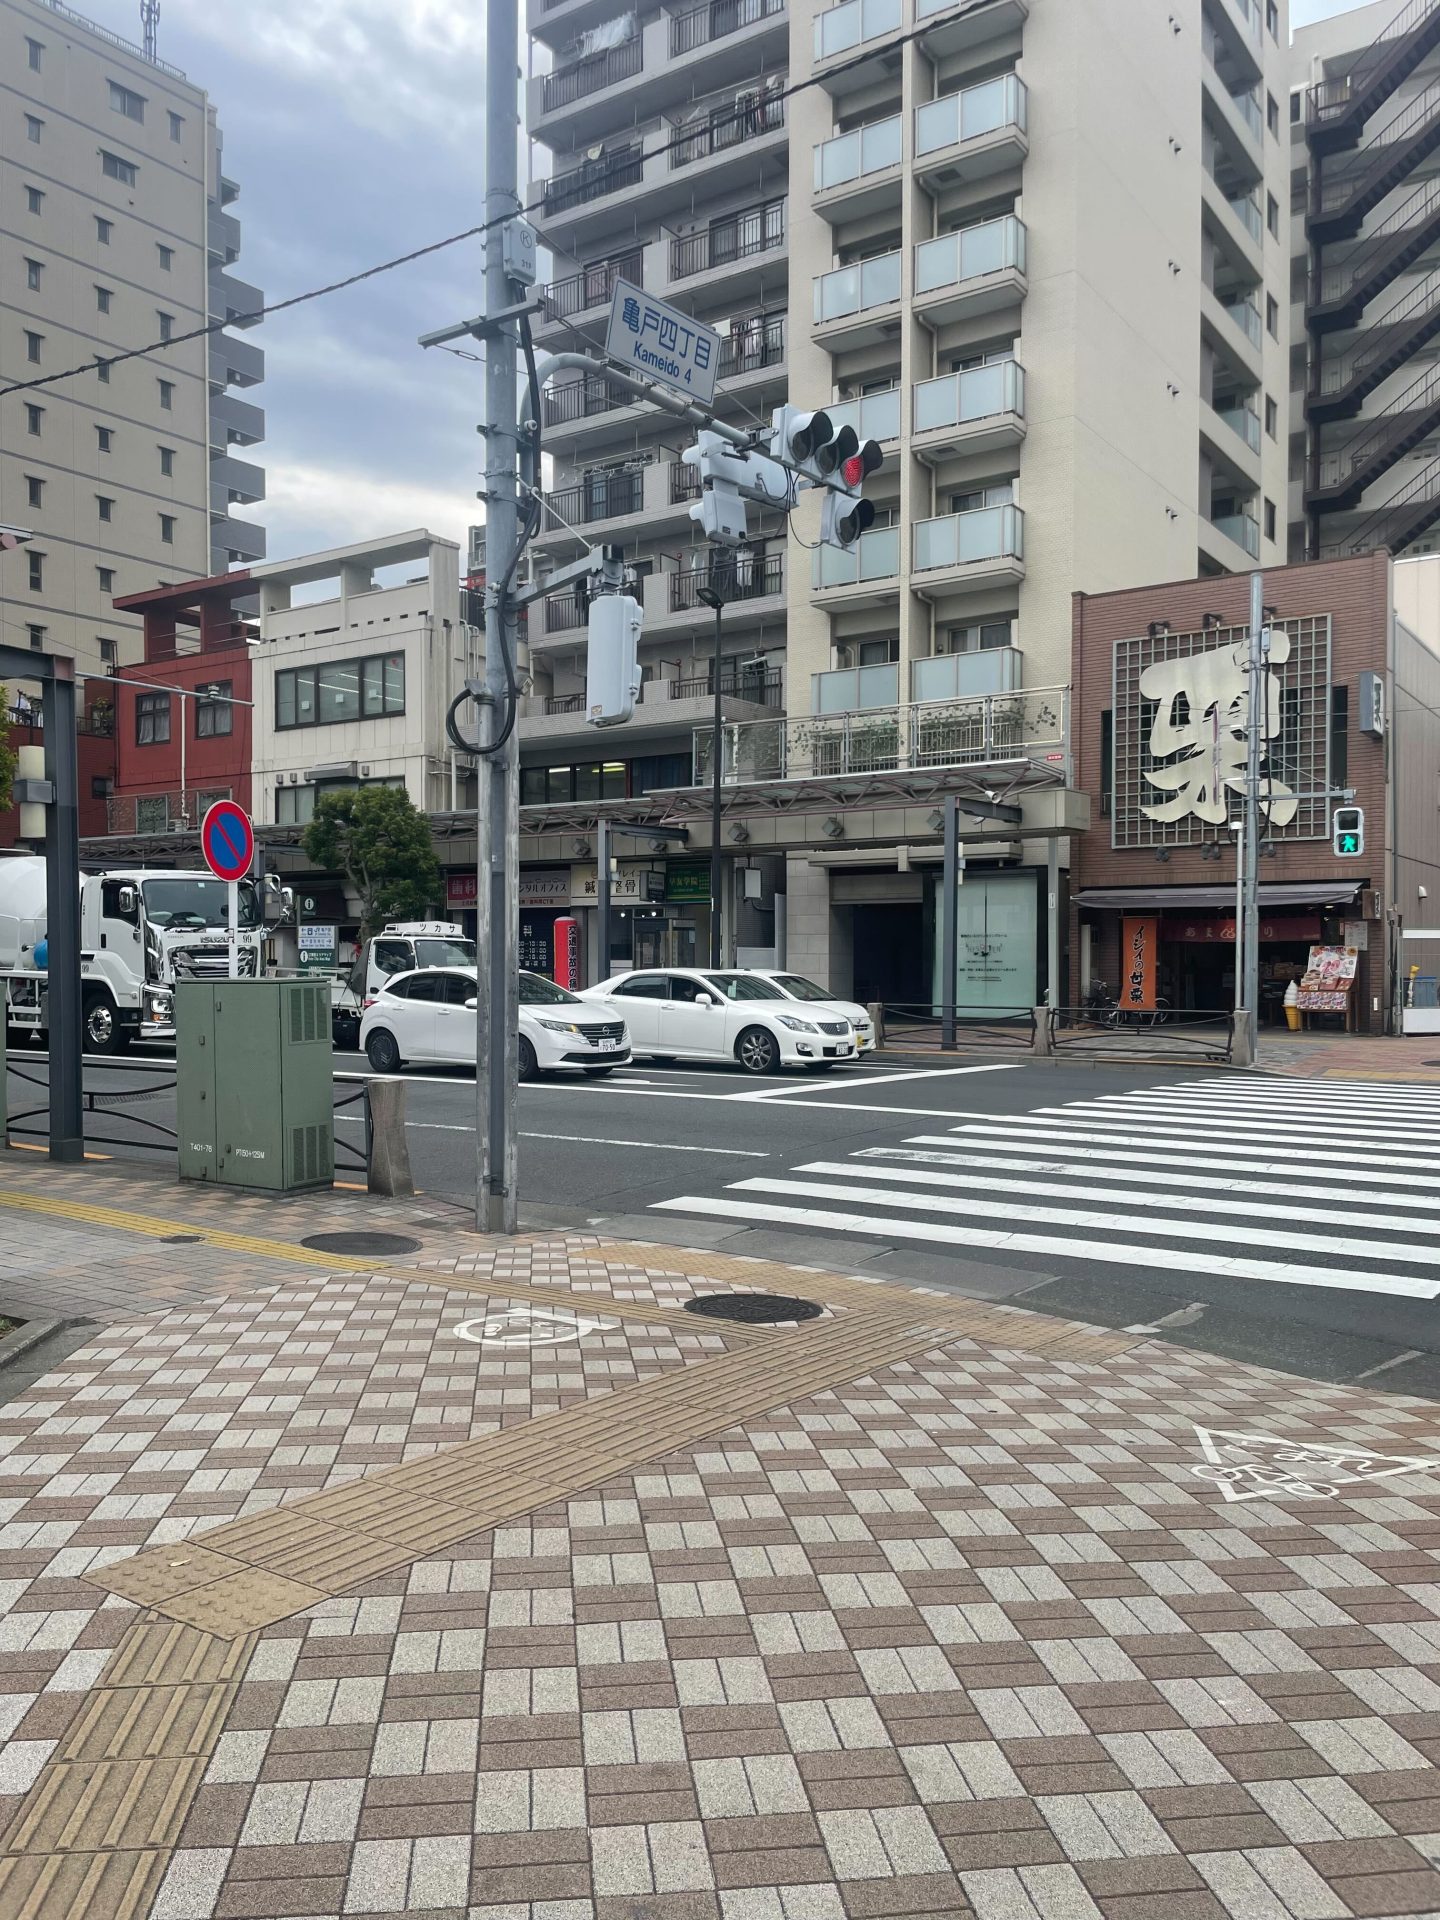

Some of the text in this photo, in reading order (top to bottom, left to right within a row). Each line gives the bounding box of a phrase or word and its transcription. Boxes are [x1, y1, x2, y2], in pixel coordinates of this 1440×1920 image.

[622, 297, 711, 370] 亀戸四丁目
[633, 340, 692, 384] Kameido 4
[1139, 630, 1299, 827] 栗
[452, 879, 477, 895] 歯科
[200, 936, 230, 944] ISUZU
[242, 935, 252, 944] 99
[419, 923, 455, 933] ツカサ
[1130, 925, 1145, 1004] イシイの甘栗
